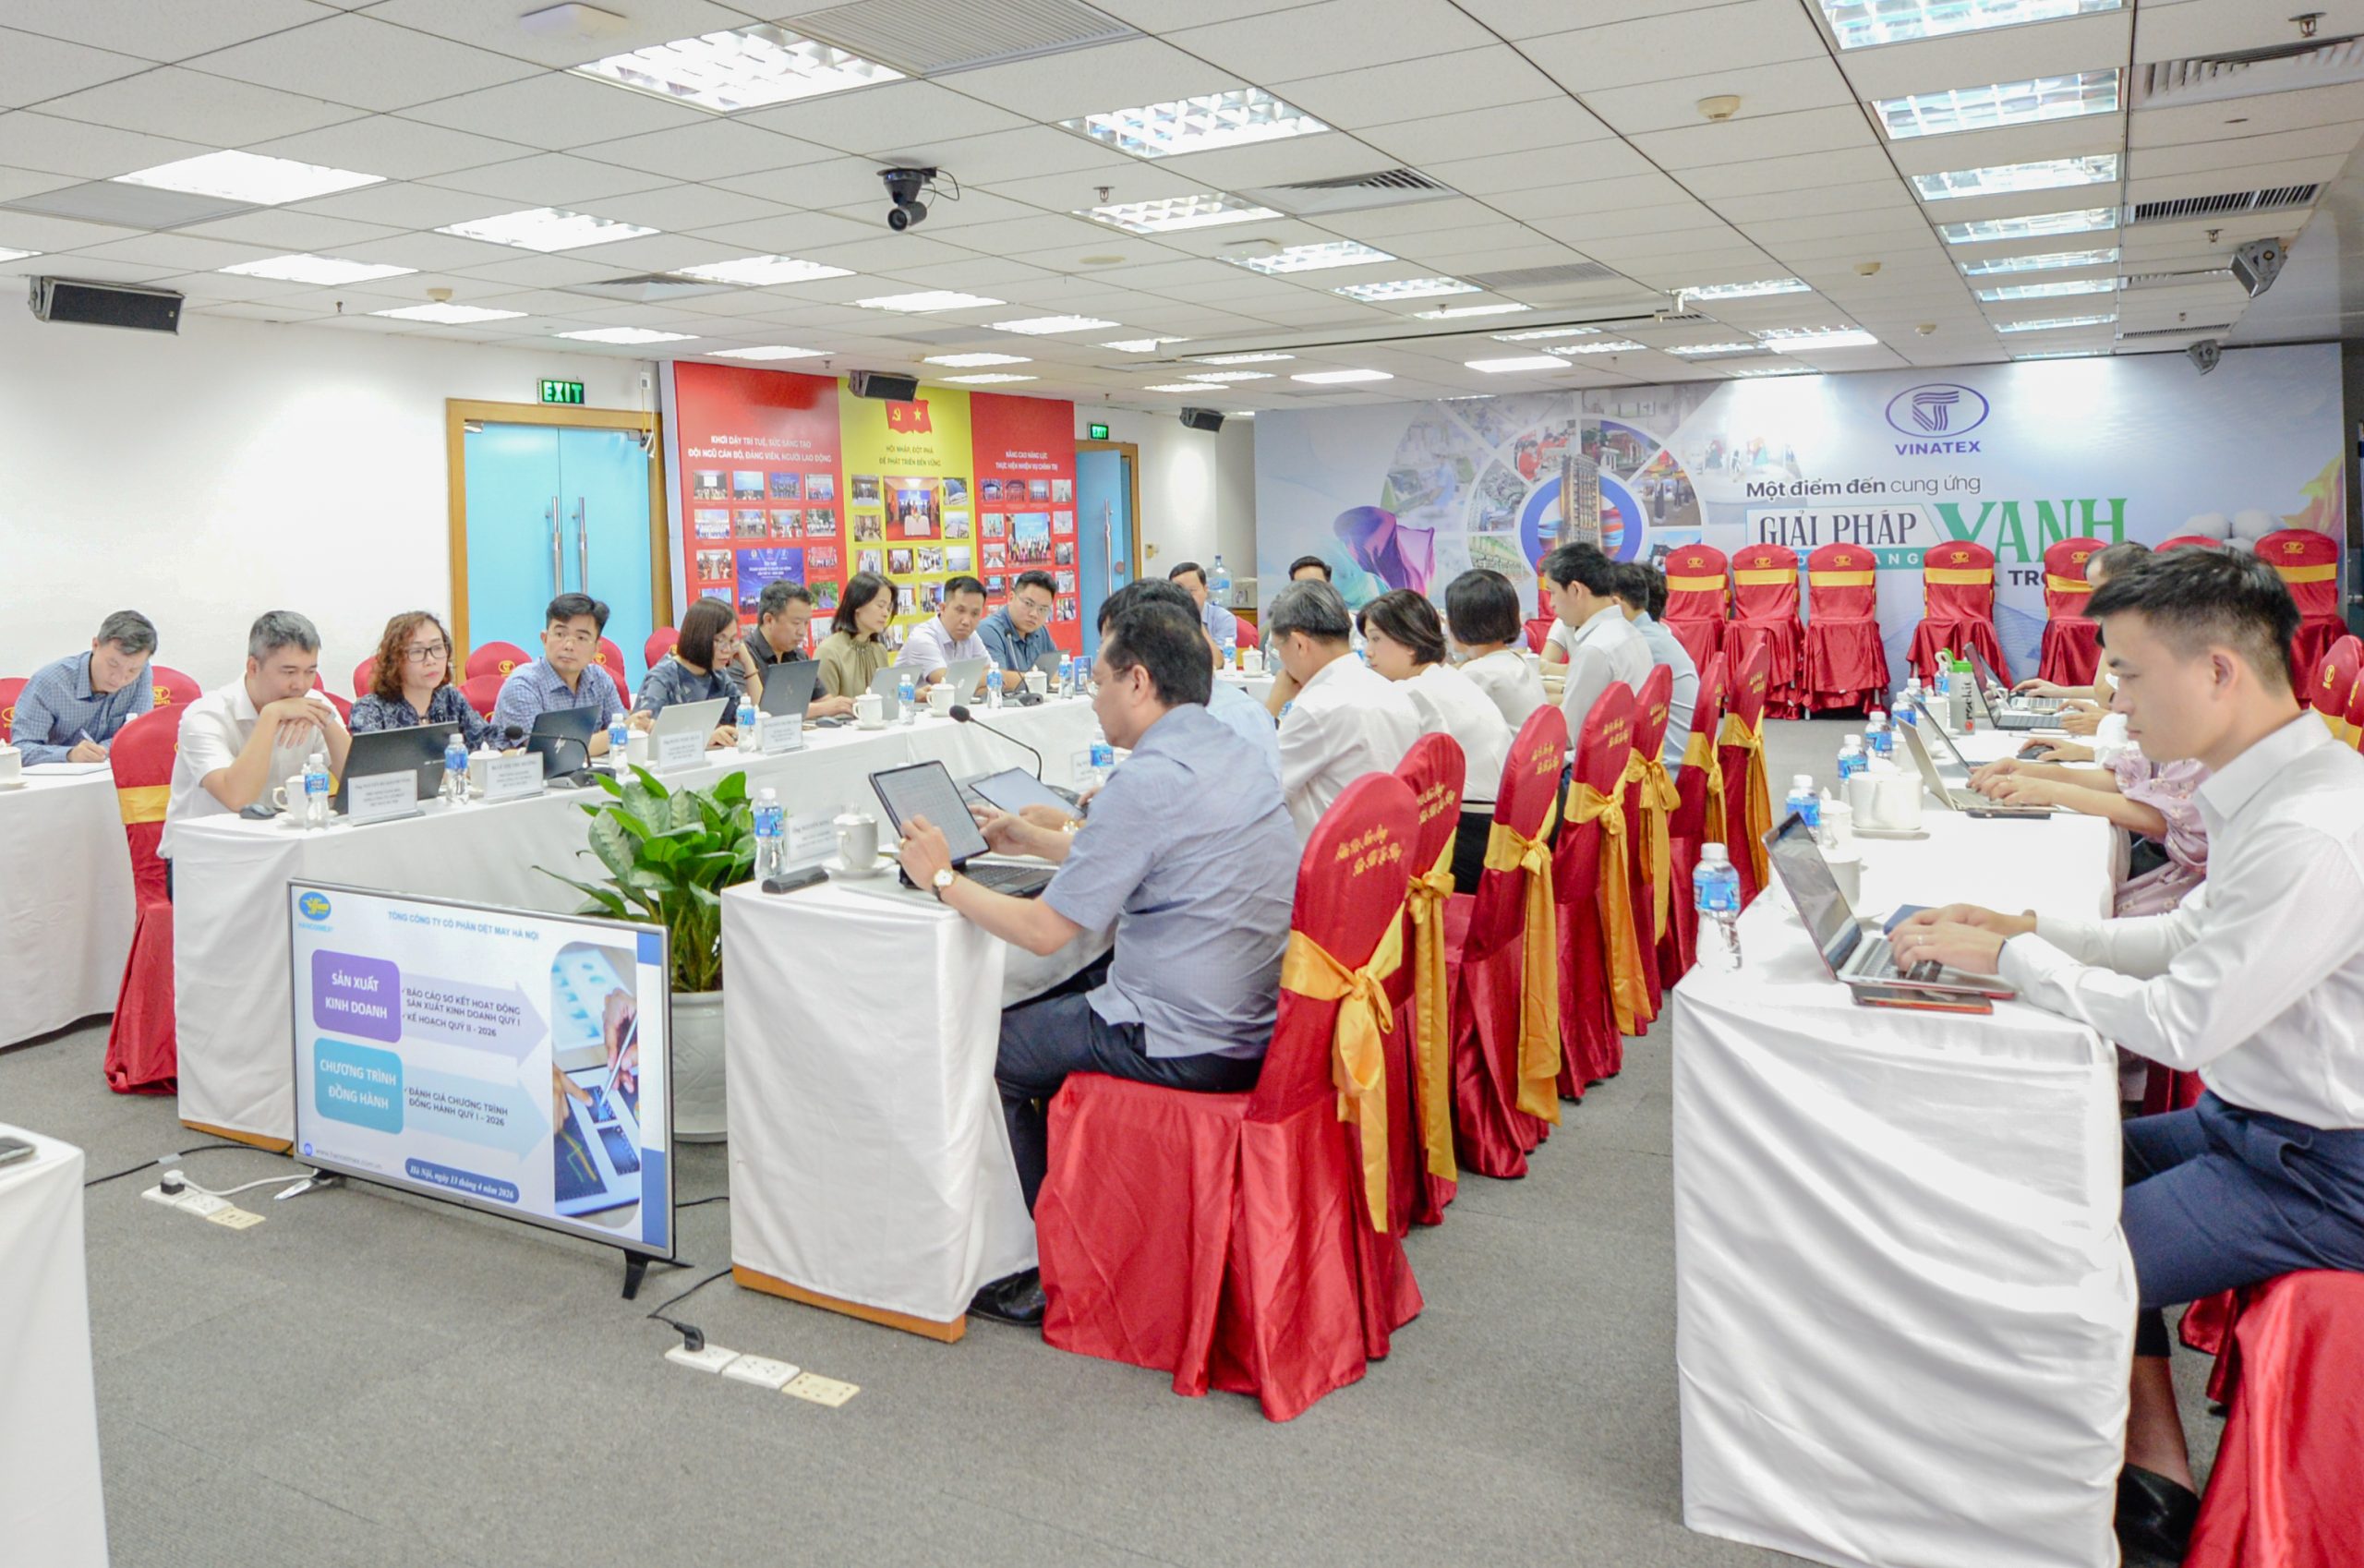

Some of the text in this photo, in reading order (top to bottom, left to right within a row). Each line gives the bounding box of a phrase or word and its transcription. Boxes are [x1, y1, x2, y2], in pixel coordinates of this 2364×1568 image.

[543, 381, 582, 404] EXIT
[1895, 440, 1981, 455] VINATEX
[1746, 474, 1981, 501] Một điểm đến cung ứng
[1760, 509, 1916, 546] GIẢI PHÁP
[432, 917, 441, 926] TY
[494, 926, 510, 936] MAY
[332, 969, 380, 993] SẢN XUẤT
[325, 996, 388, 1019] KINH DOANH
[406, 987, 423, 998] BÁO
[455, 994, 470, 1007] KẾT
[446, 1006, 465, 1017] KINH
[466, 1008, 497, 1022] DOANH
[478, 1026, 497, 1037] 2026
[320, 1058, 396, 1087] CHƯƠNG TRÌNH
[328, 1082, 389, 1110] ĐỒNG HÀNH
[486, 1115, 505, 1127] 2026
